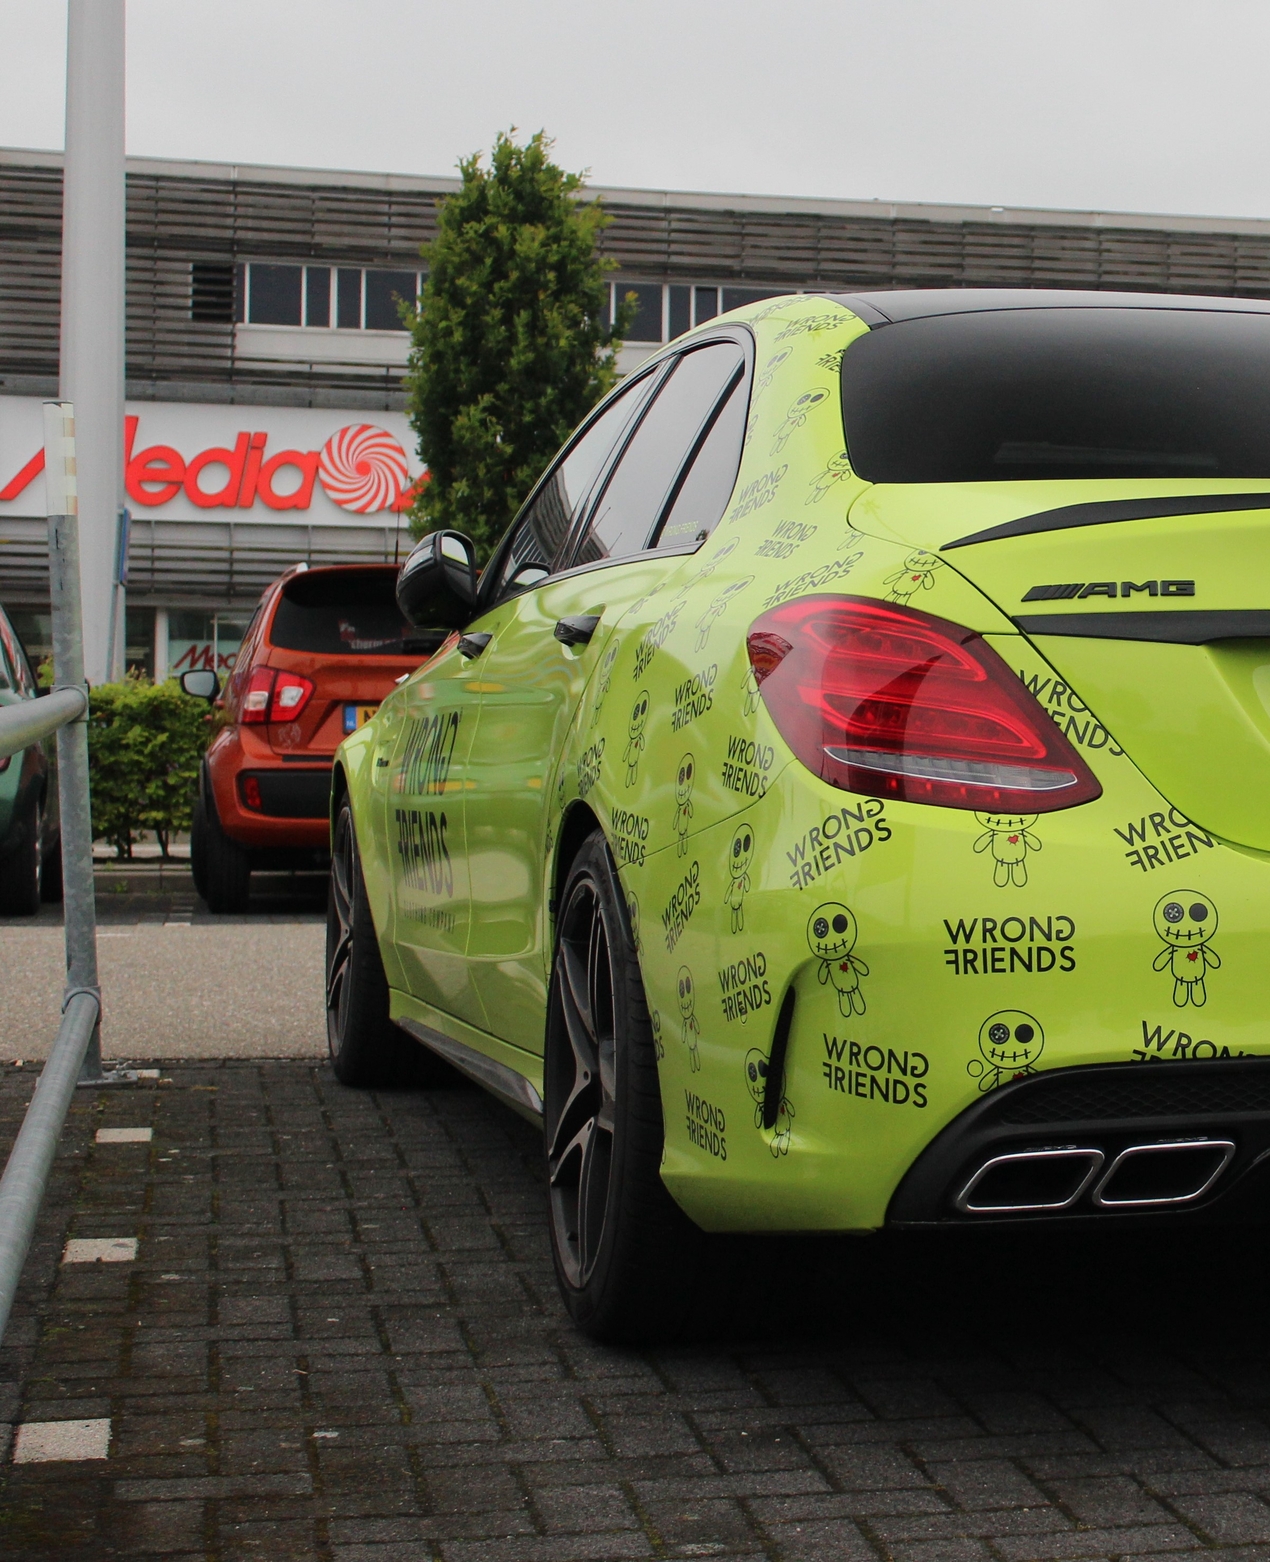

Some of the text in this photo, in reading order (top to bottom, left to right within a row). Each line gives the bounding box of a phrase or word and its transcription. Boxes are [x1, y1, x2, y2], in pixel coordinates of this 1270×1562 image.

[728, 484, 779, 525] FRIENDS
[738, 464, 789, 505] WRONG
[754, 539, 800, 559] FRIENDS
[771, 519, 818, 542] WRONG
[762, 565, 854, 609] FRIENDS
[775, 551, 865, 594] WRONG
[1078, 580, 1195, 598] AMG
[632, 615, 679, 682] FRIENDS
[635, 600, 687, 662] WRONG
[675, 663, 718, 708] WRONG
[1019, 669, 1094, 718] WRO
[671, 688, 714, 733] FRIENDS
[727, 735, 774, 771] WRONG
[721, 762, 768, 799] FRIENDS
[611, 807, 649, 840] WRONG
[785, 798, 885, 868] WRONG
[1113, 807, 1193, 847] WRO
[789, 818, 892, 891] FRIENDS
[1125, 831, 1221, 873] FRIEN
[661, 860, 699, 929] WRONG
[665, 883, 701, 954] FRIENDS
[943, 915, 1076, 945] WRONG
[718, 951, 767, 995] WRONG
[943, 945, 1076, 975] FRIENDS
[721, 980, 772, 1023] FRIENDS
[822, 1033, 929, 1078] WRONG
[822, 1061, 928, 1109] FRIENDS
[685, 1088, 726, 1133] WRONG
[686, 1115, 727, 1162] FRIENDS
